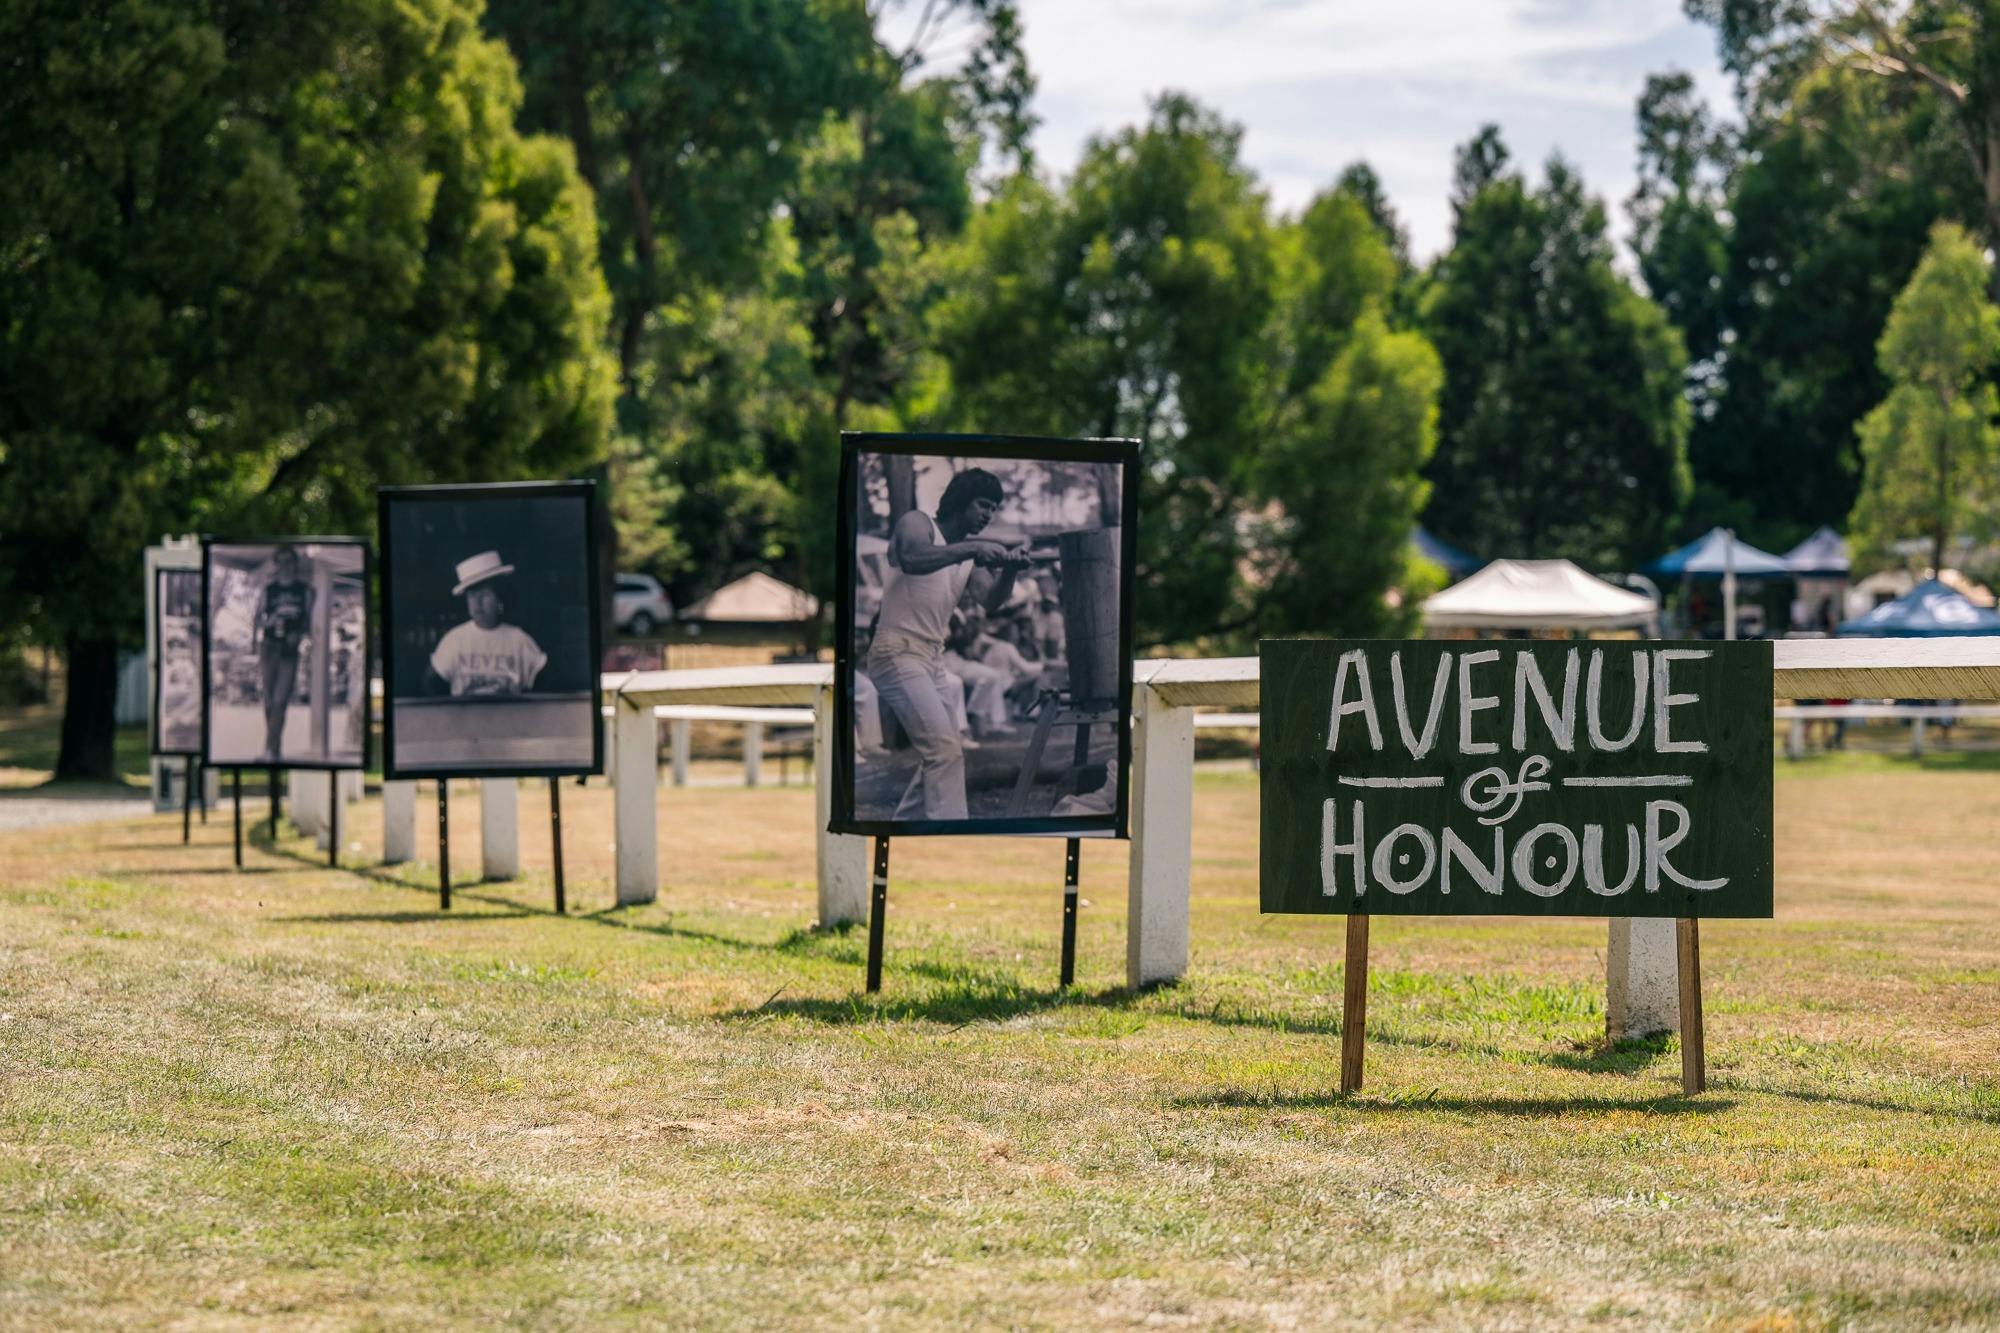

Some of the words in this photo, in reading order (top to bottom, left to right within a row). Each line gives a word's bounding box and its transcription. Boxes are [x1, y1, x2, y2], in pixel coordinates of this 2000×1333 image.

[1326, 648, 1714, 760] AVENUE
[1460, 754, 1551, 825] of
[1320, 798, 1730, 898] HONOUR
